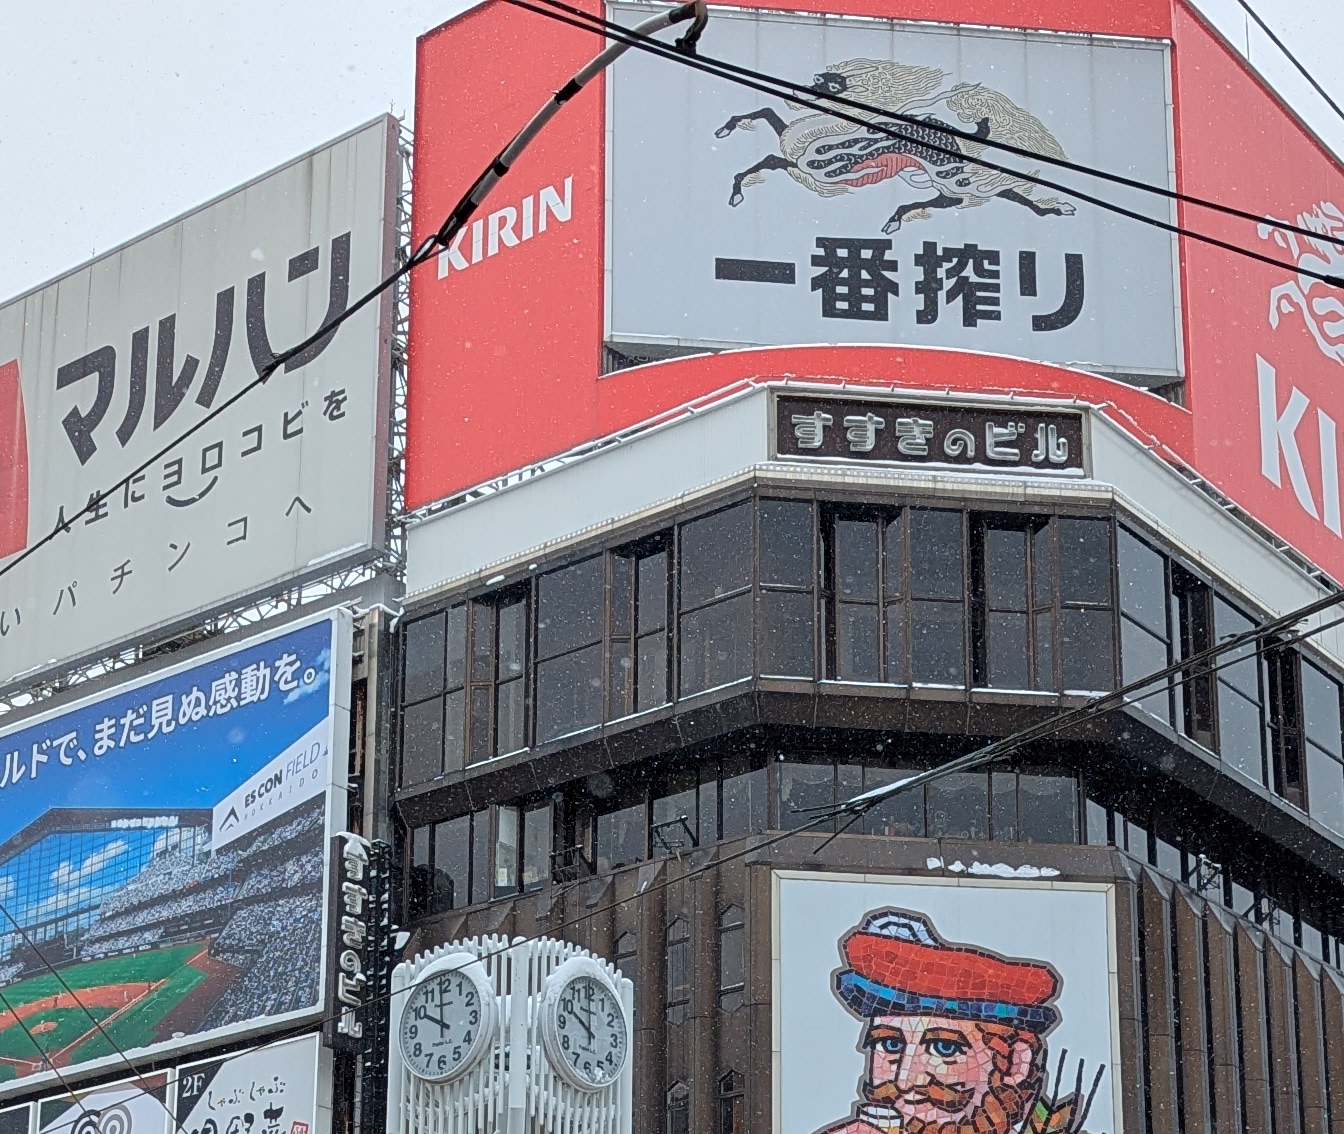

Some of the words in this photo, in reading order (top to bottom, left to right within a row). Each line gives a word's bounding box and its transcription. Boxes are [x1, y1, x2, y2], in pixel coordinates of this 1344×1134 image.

[436, 173, 575, 281] KIRIN
[714, 236, 1087, 332] 一番搾り
[56, 230, 352, 466] マルハン
[790, 410, 1070, 466] すすきのビル
[50, 386, 350, 540] 人生にヨロコビを
[244, 768, 283, 810] ESCON
[285, 741, 321, 781] FIELD
[437, 979, 451, 993] 12
[456, 981, 462, 996] 1
[583, 983, 595, 998] 12
[423, 988, 435, 1003] 11
[465, 991, 474, 1007] 2
[570, 986, 581, 1002] 11
[561, 998, 573, 1014] 10
[599, 998, 605, 1012] 1
[412, 1005, 427, 1021] 10
[469, 1010, 478, 1025] 3
[606, 1013, 615, 1028] 2
[558, 1014, 566, 1029] 9
[409, 1025, 418, 1040] 9
[463, 1030, 472, 1045] 4
[561, 1035, 570, 1050] 8
[610, 1034, 618, 1048] 3
[413, 1042, 422, 1058] 8
[452, 1046, 461, 1061] 5
[424, 1053, 433, 1068] 7
[438, 1055, 446, 1070] 6
[572, 1052, 580, 1067] 7
[605, 1051, 613, 1066] 4
[182, 1073, 206, 1098] 2F
